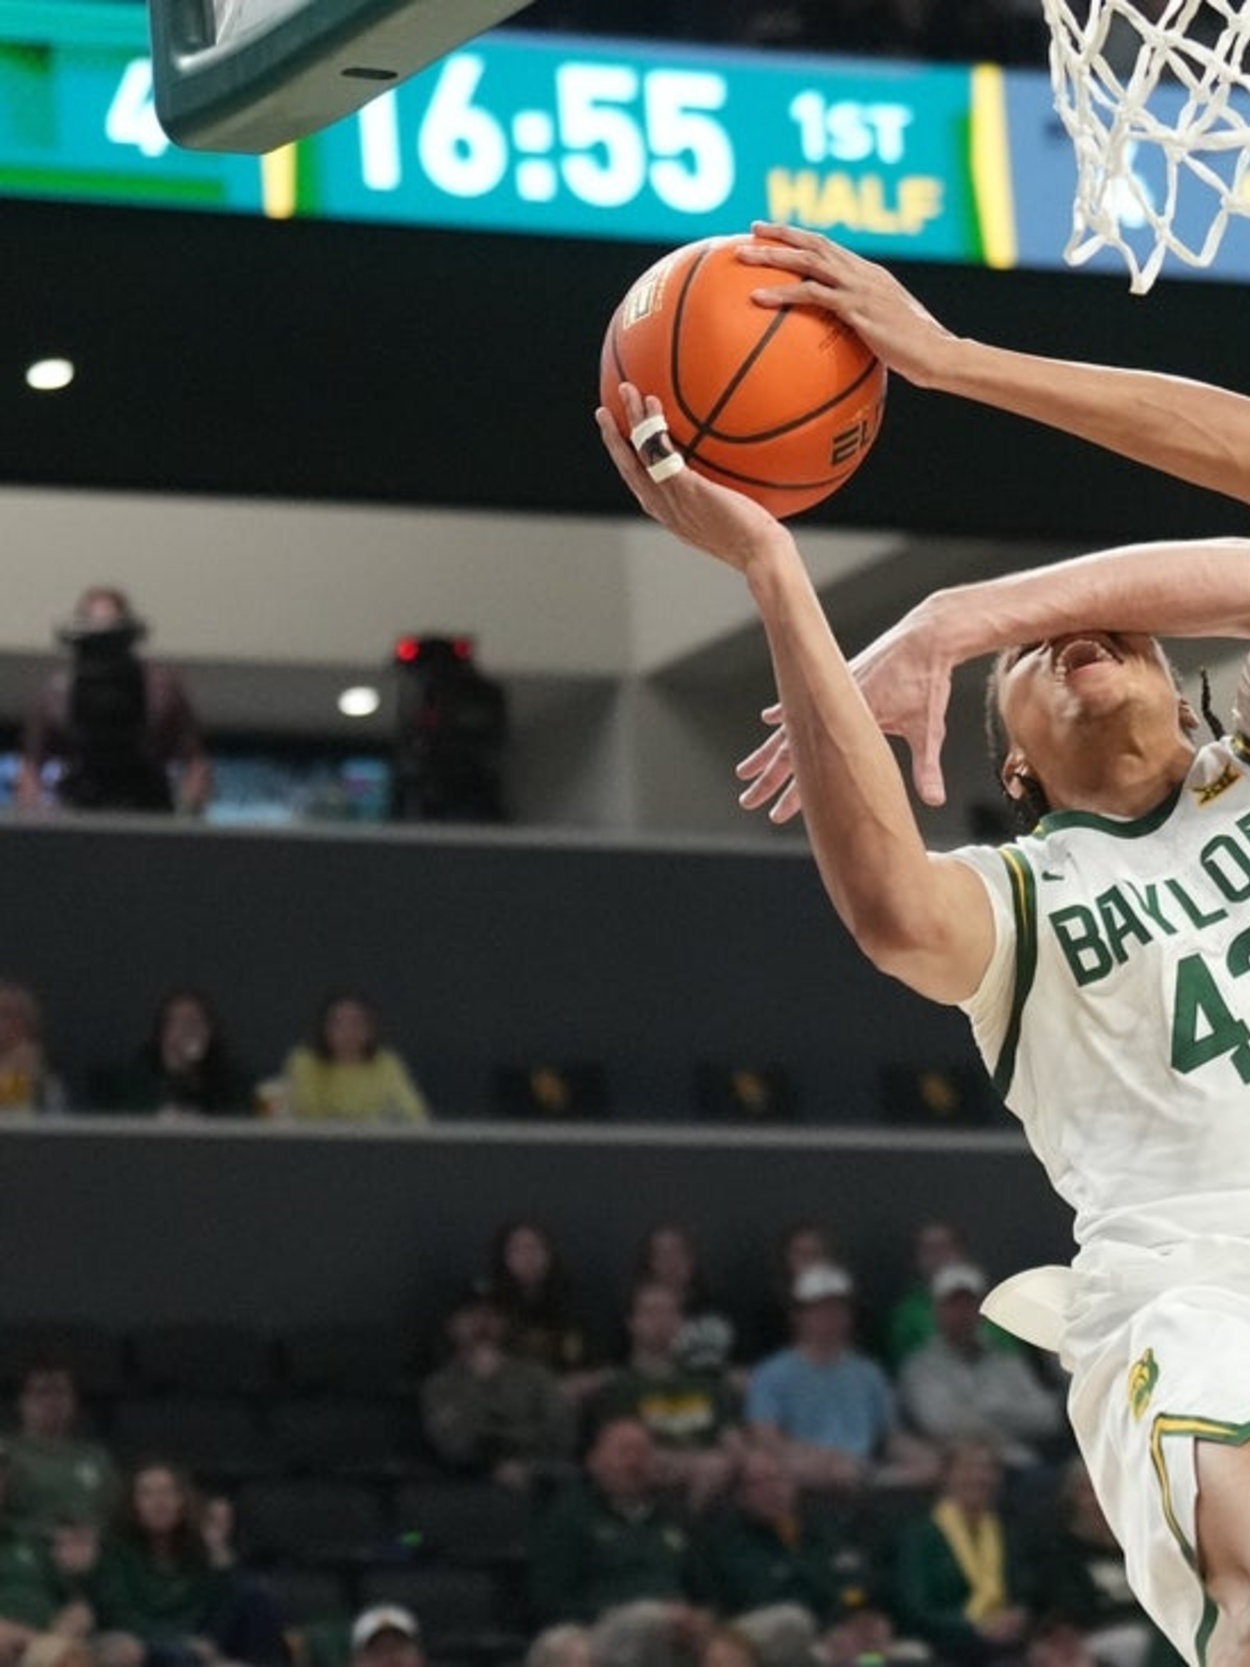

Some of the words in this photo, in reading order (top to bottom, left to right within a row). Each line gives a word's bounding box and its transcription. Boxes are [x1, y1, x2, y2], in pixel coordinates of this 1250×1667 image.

[357, 53, 735, 213] 16:55
[790, 91, 911, 163] 1ST
[767, 168, 942, 233] HALF
